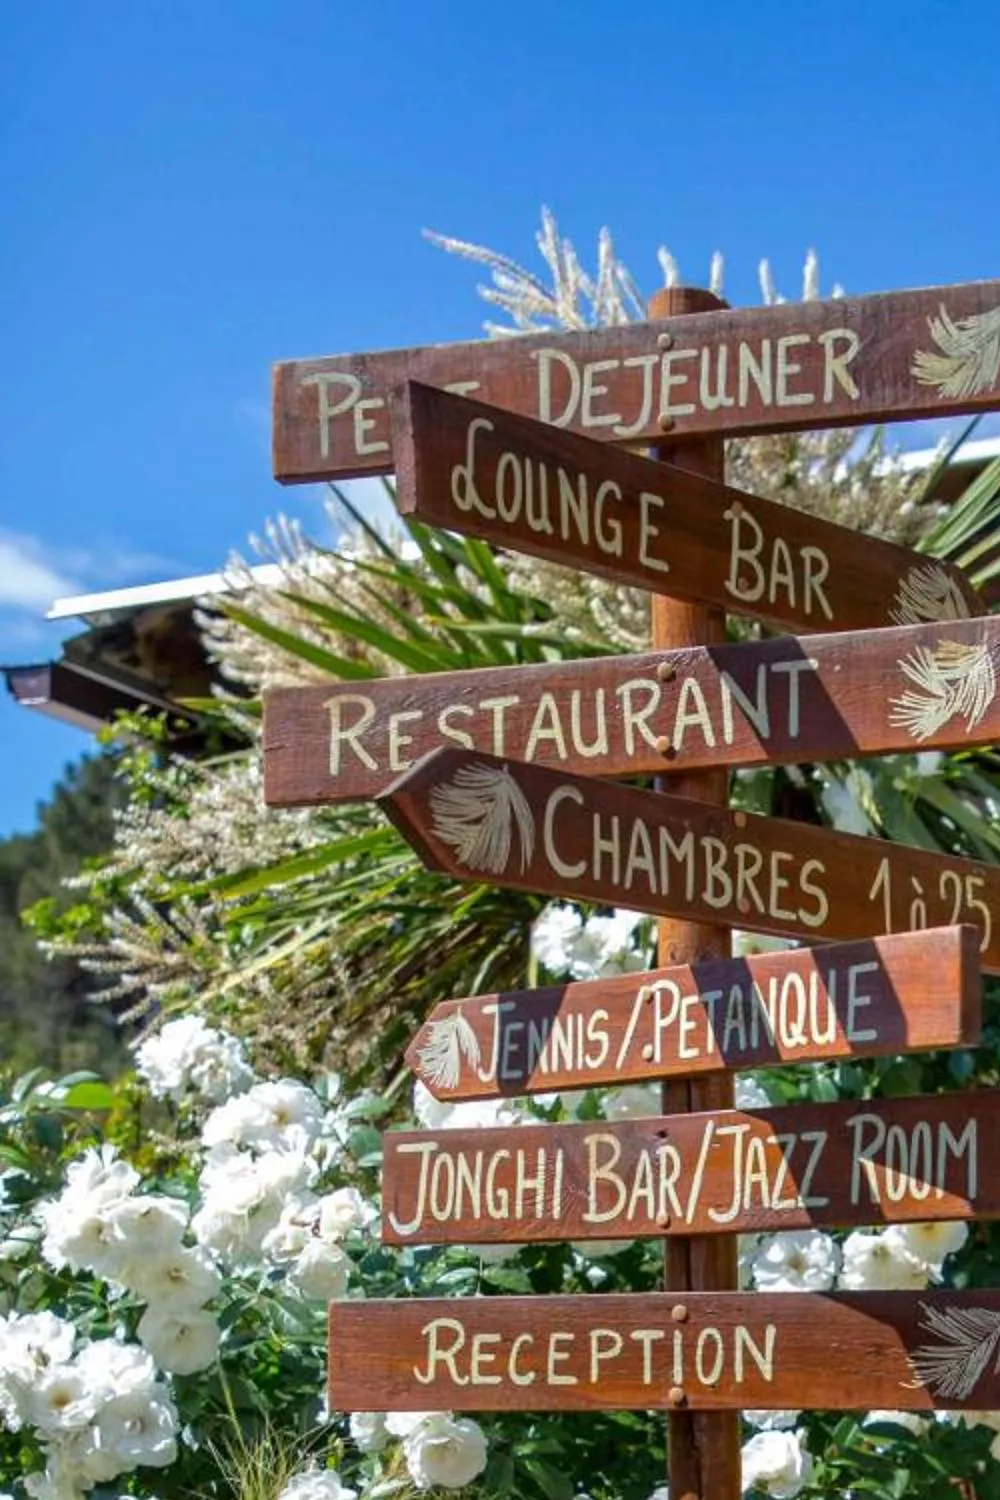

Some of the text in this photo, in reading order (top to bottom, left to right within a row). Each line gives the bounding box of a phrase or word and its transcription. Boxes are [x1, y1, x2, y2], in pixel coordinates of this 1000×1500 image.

[451, 418, 833, 620] LOUNGE BAR
[322, 658, 819, 775] RESTAURANT
[543, 784, 829, 928] CHAMBRES
[869, 857, 892, 935] 1
[388, 1141, 563, 1236] JONGHI
[846, 1113, 978, 1206] ROOM
[413, 1317, 777, 1386] RECEPTION
